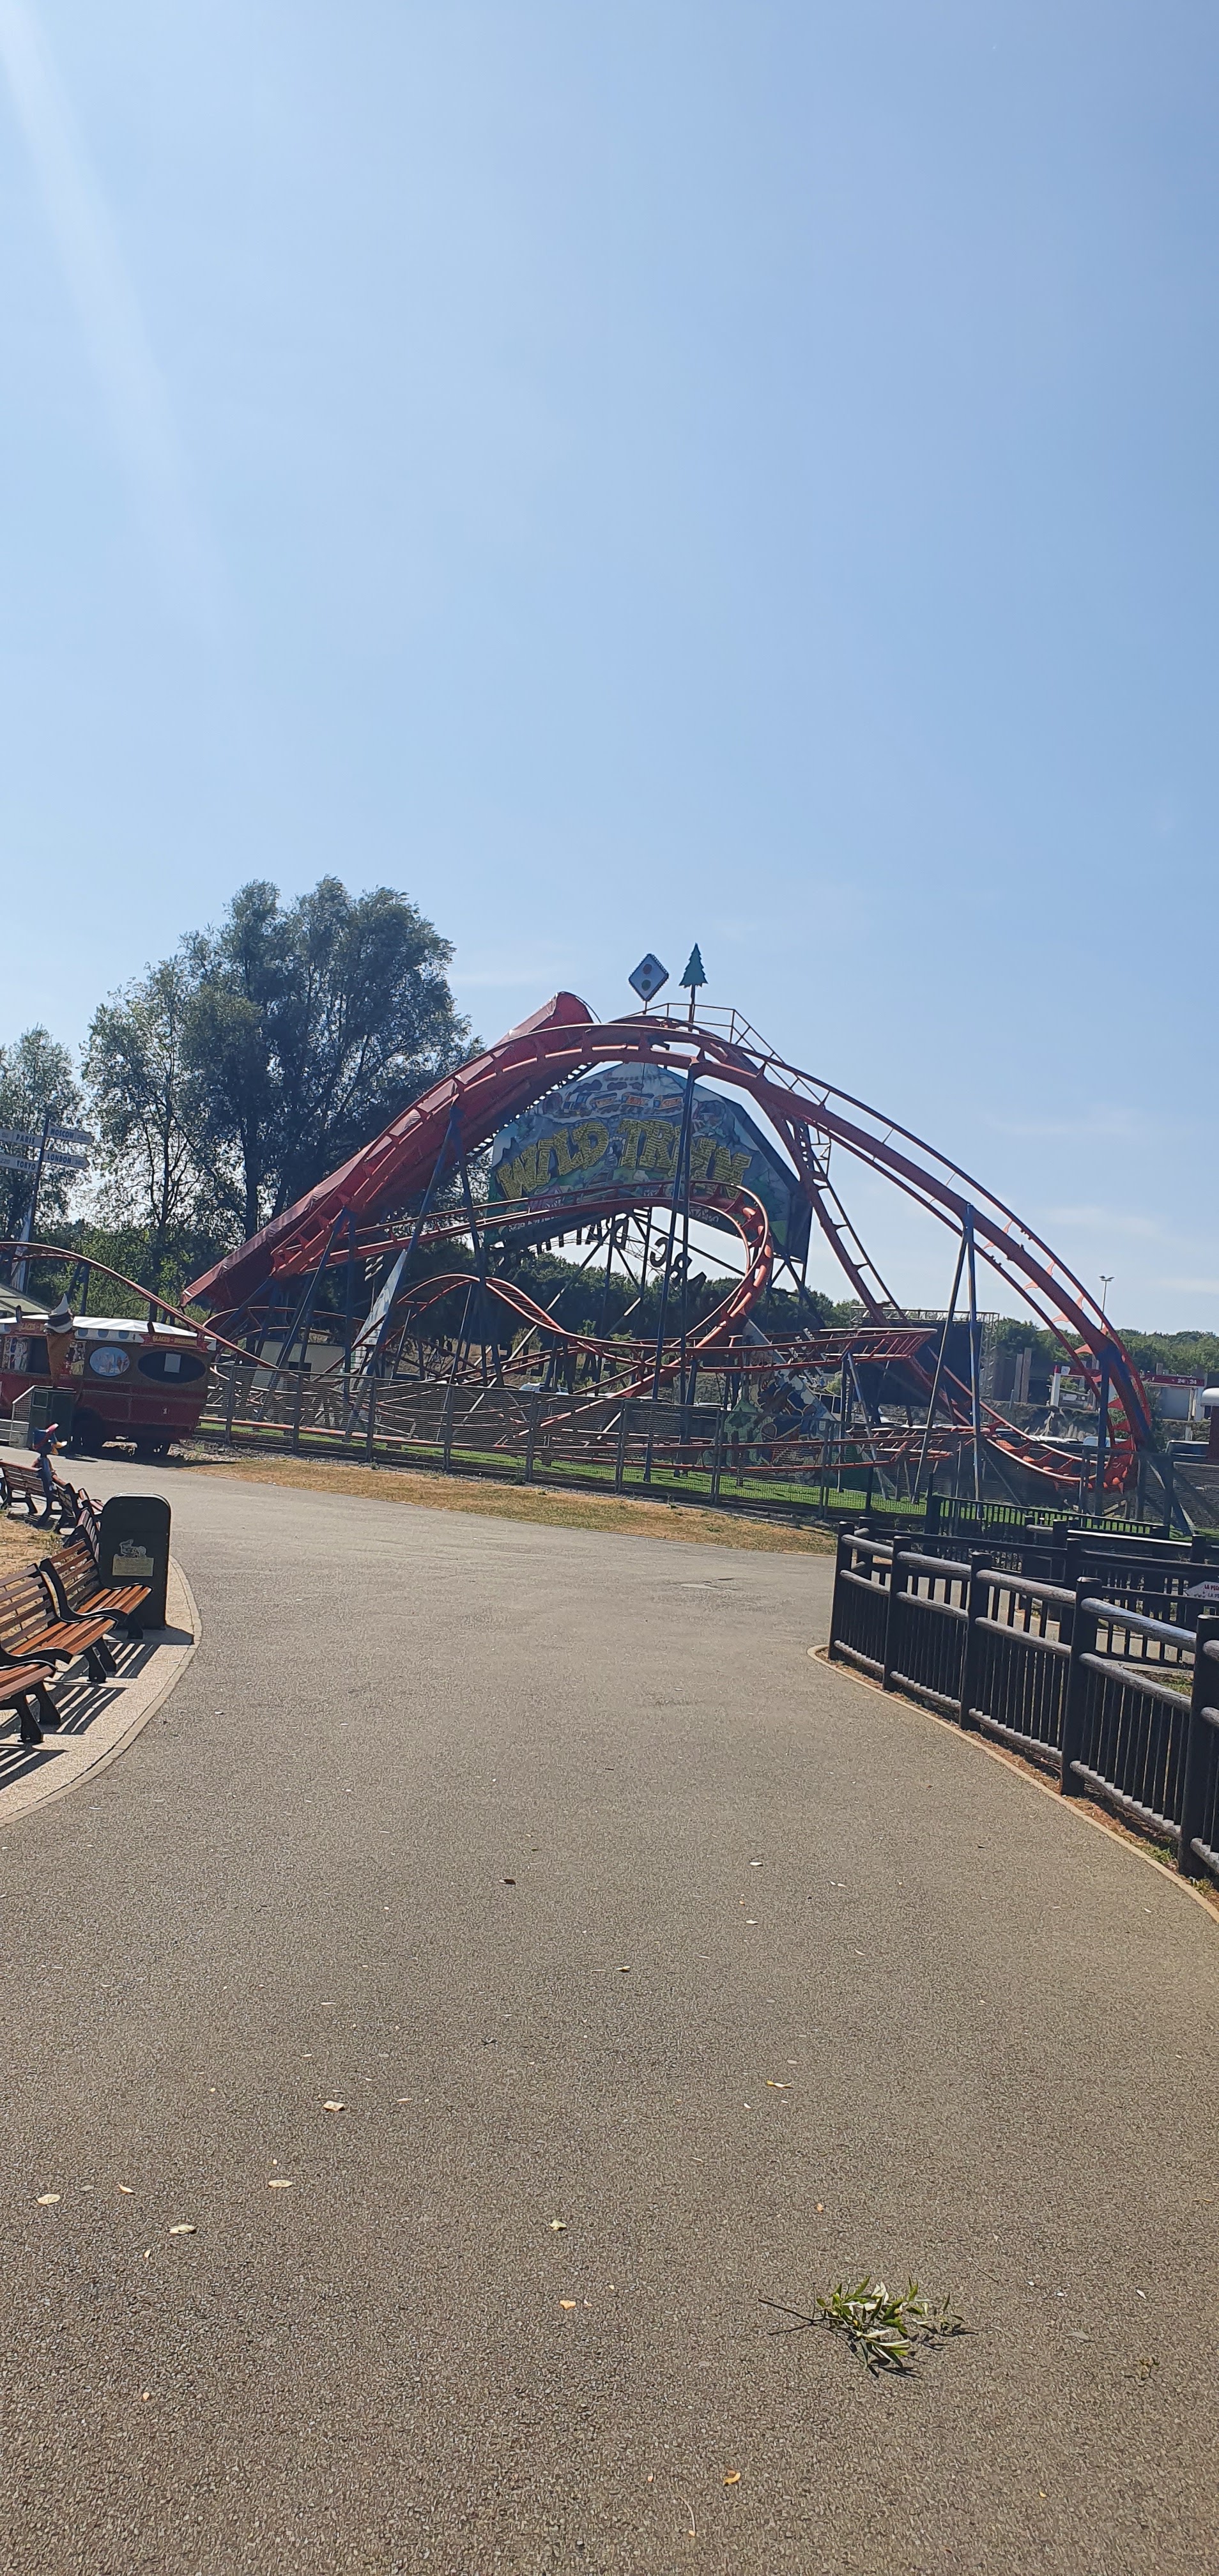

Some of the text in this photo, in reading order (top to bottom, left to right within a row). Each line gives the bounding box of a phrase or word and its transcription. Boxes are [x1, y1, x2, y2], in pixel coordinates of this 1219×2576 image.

[50, 1128, 74, 1138] MOSCOW
[16, 1134, 35, 1144] PARIS
[47, 1153, 72, 1163] LONDON
[496, 1118, 753, 1199] WILD TRAIN
[17, 1160, 35, 1170] TOKYO
